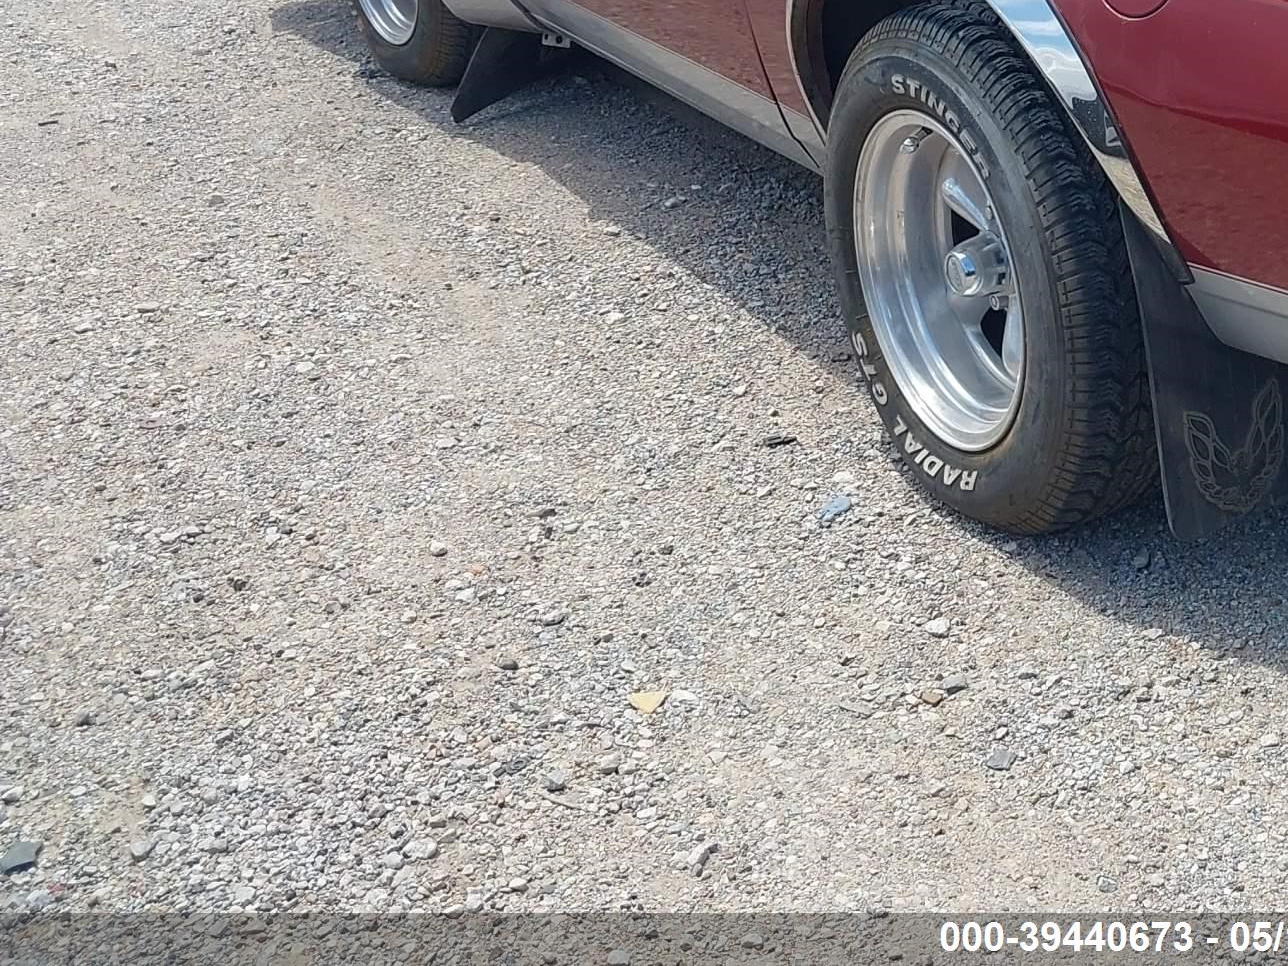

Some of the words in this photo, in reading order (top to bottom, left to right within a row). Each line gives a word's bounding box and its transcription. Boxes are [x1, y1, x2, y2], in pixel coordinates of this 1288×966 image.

[891, 73, 991, 180] STINGER
[851, 332, 888, 406] GTS
[893, 414, 978, 491] RADIAL
